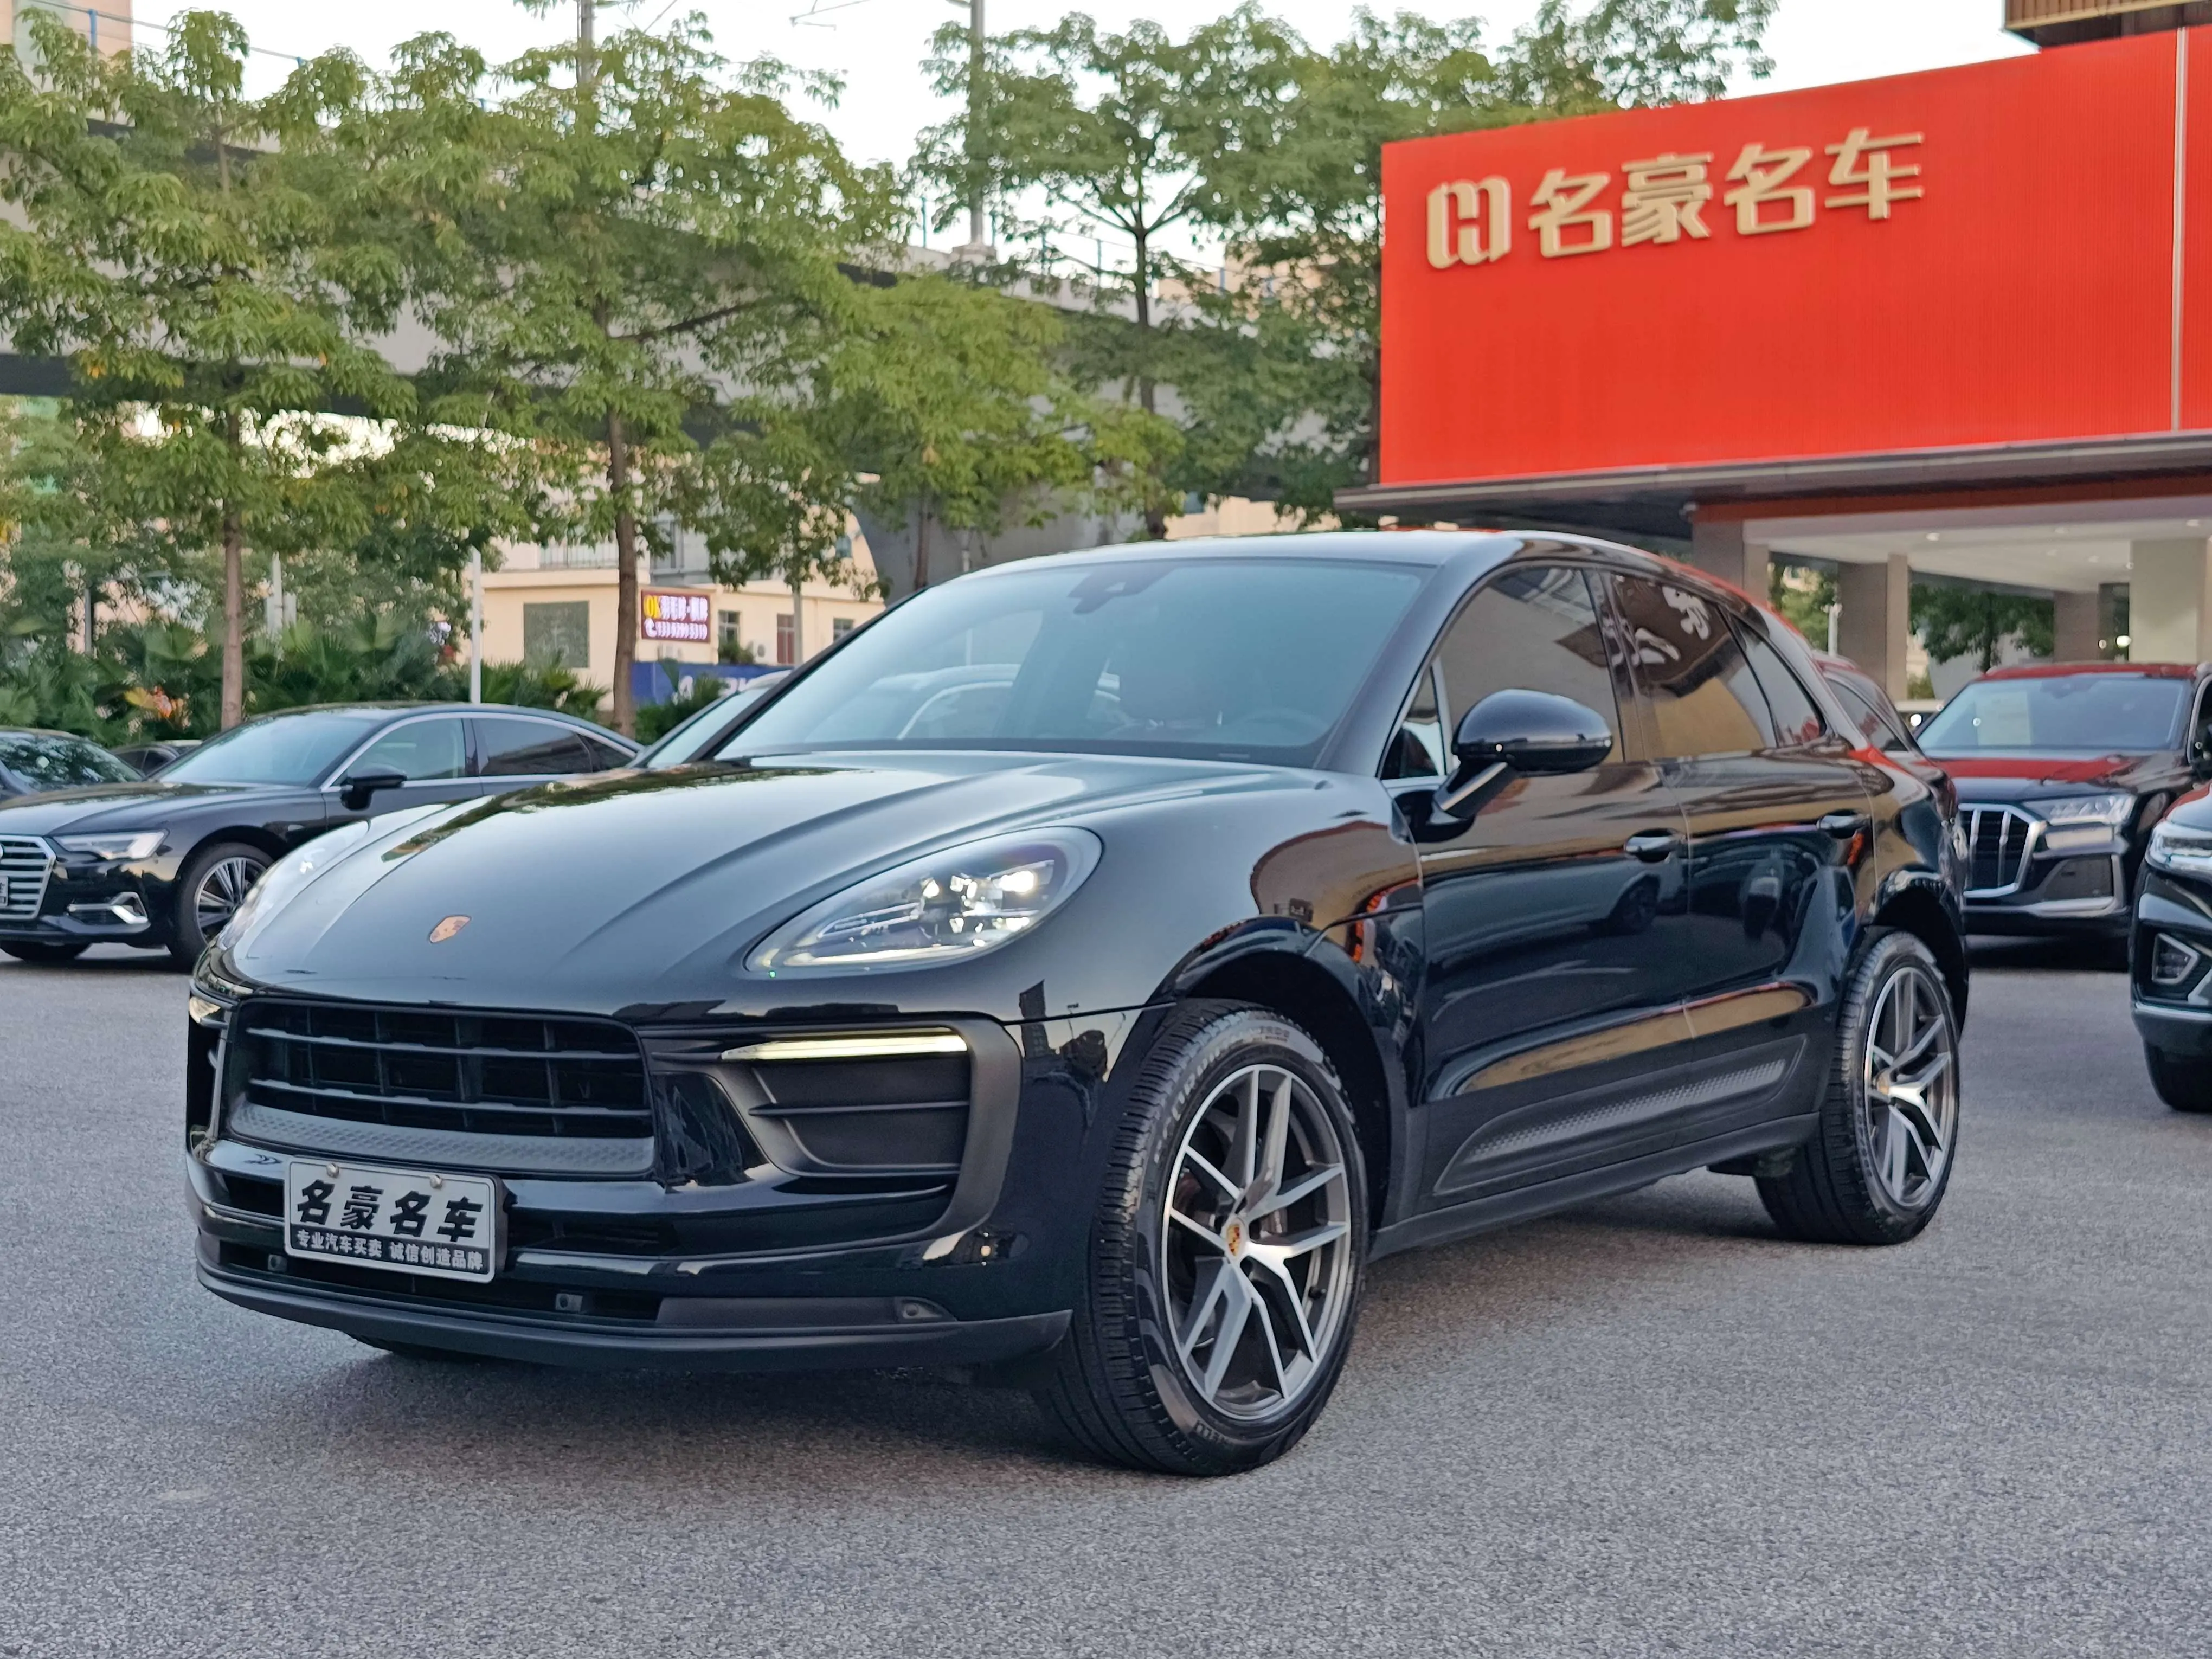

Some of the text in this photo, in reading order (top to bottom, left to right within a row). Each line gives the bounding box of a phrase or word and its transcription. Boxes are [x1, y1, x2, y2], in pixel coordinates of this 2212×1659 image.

[1528, 127, 1924, 259] 名豪名车
[297, 1179, 484, 1243] 名豪名车
[297, 1229, 483, 1271] 专业汽车买卖 诚信创造品牌
